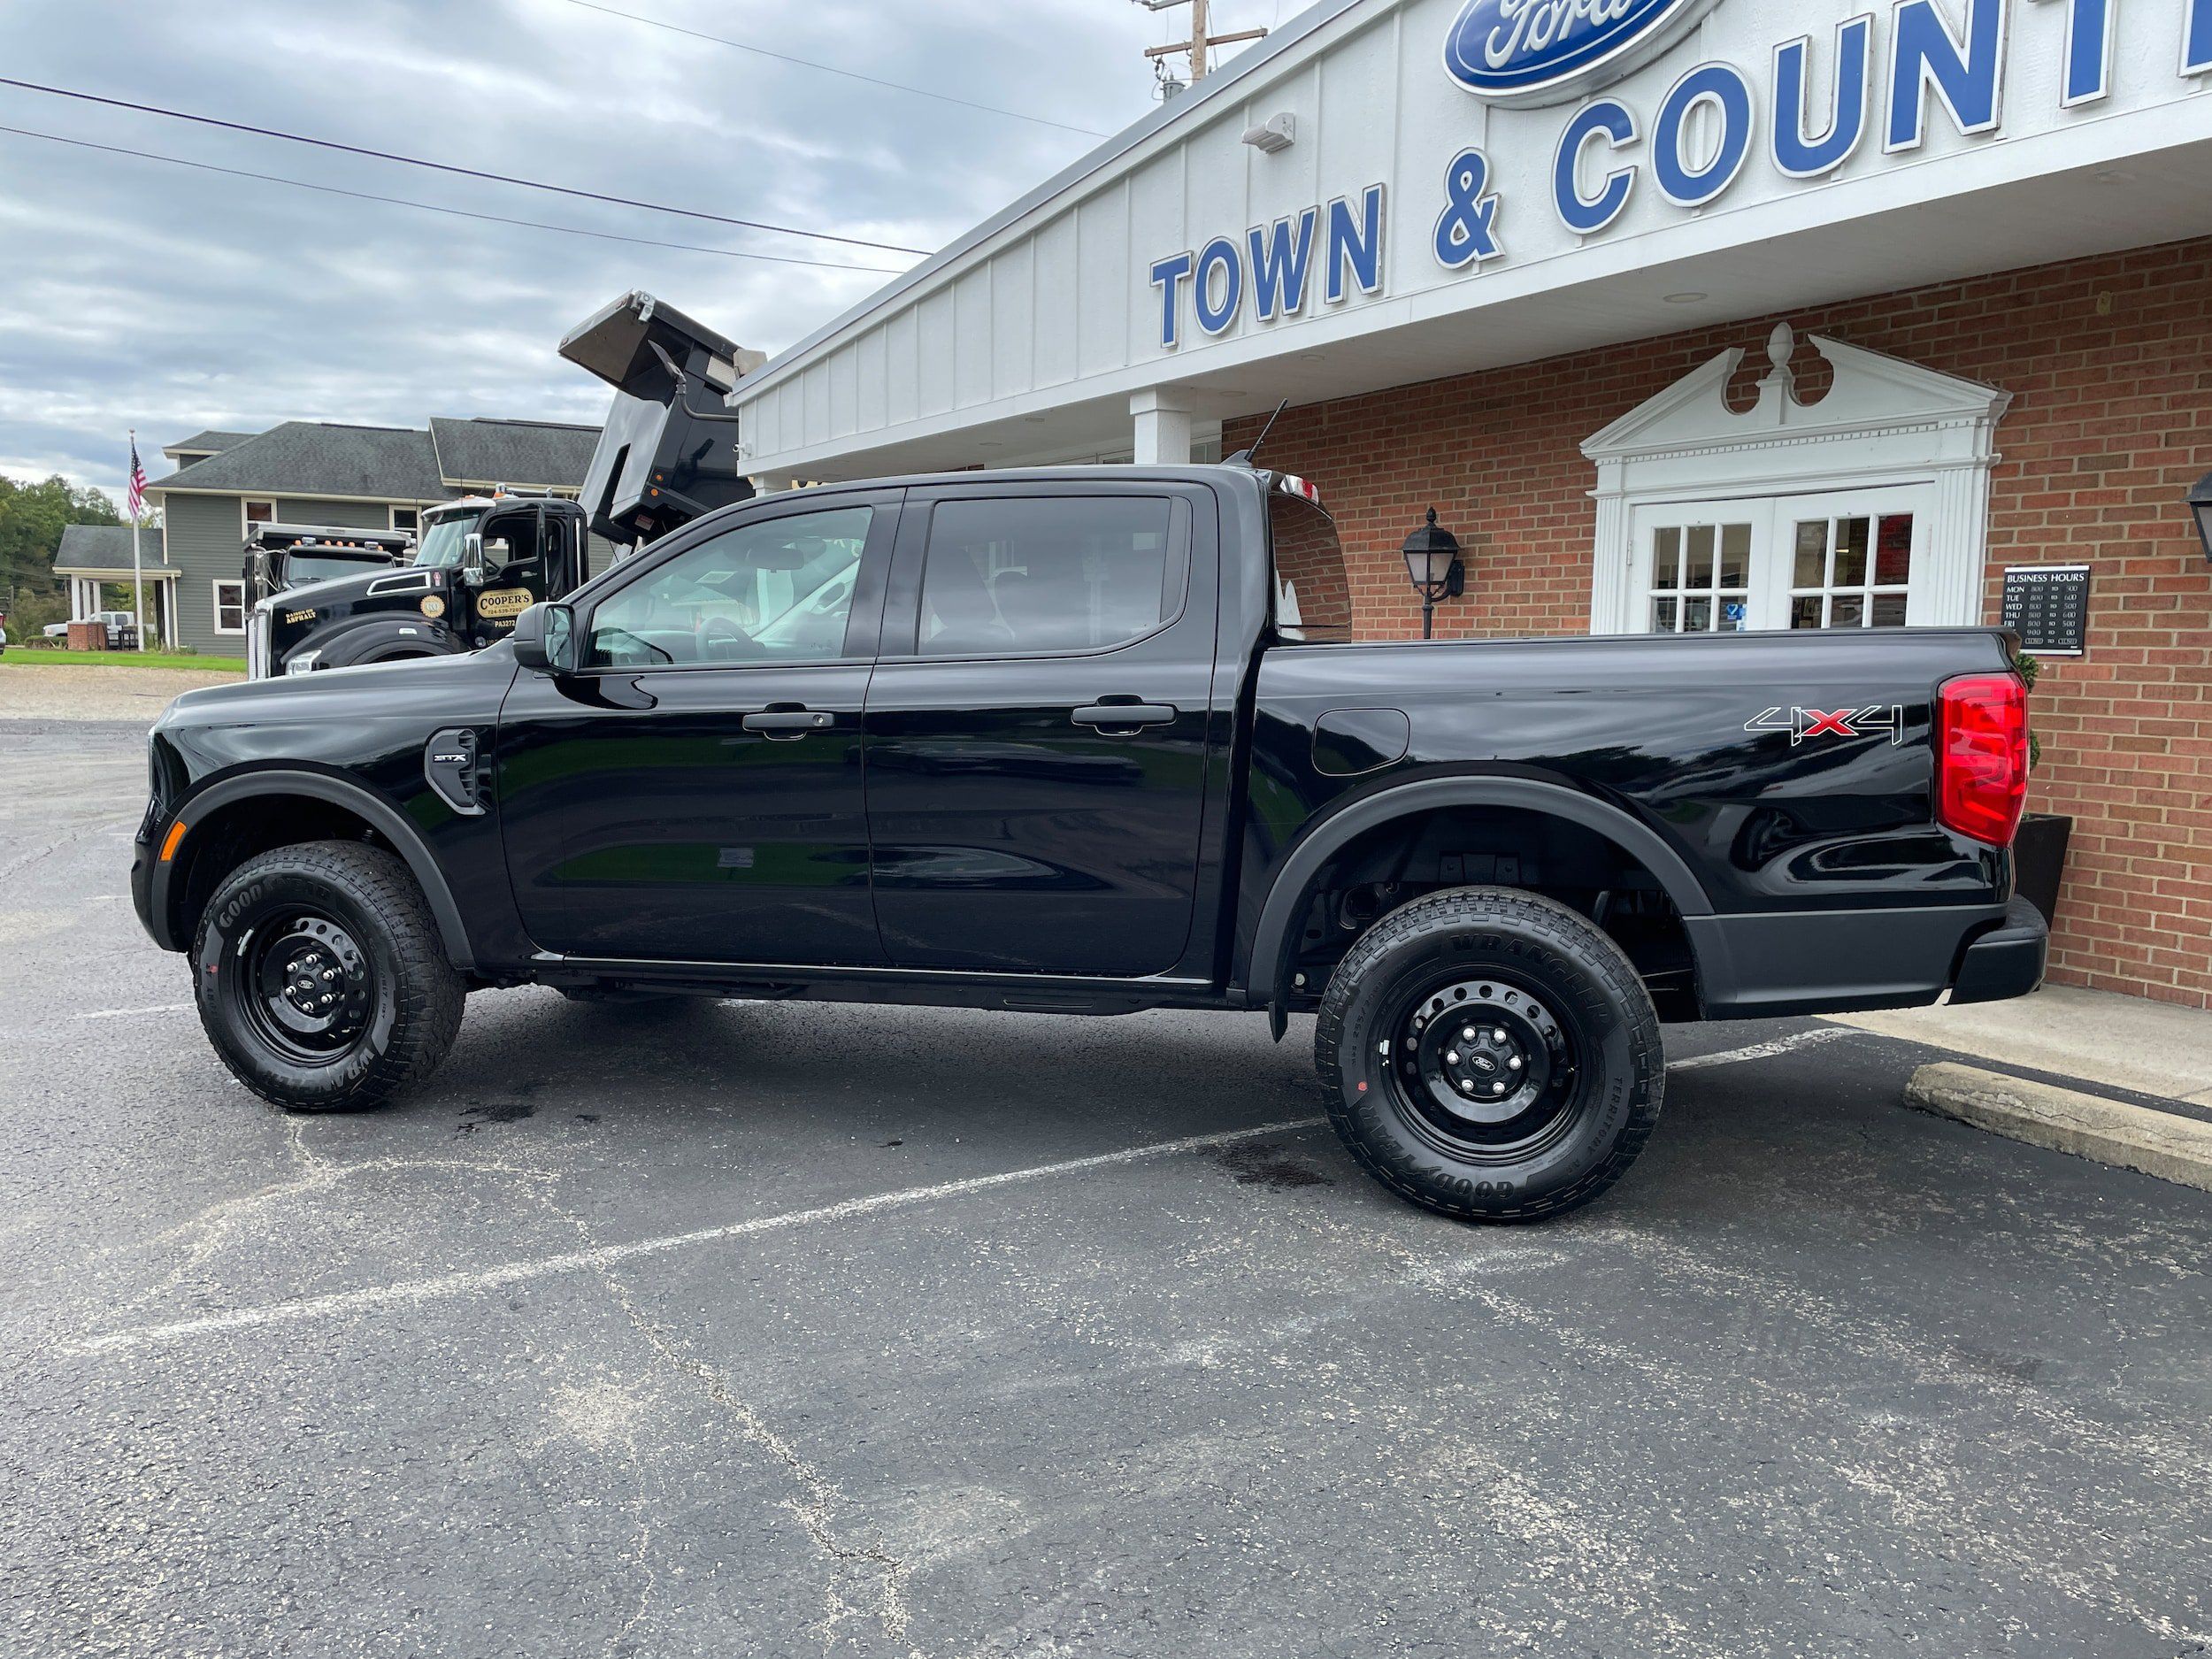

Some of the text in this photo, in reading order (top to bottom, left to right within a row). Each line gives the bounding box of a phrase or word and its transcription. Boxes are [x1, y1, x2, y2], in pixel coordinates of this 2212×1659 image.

[1150, 0, 2212, 349] TOWN & COUNT
[2007, 572, 2085, 583] BUSINESS HOURS
[287, 611, 317, 625] ASPHALT
[480, 594, 530, 610] COOPER'S
[1587, 1077, 1624, 1156] TERRITORY
[1358, 1105, 1515, 1196] GOODYEAR
